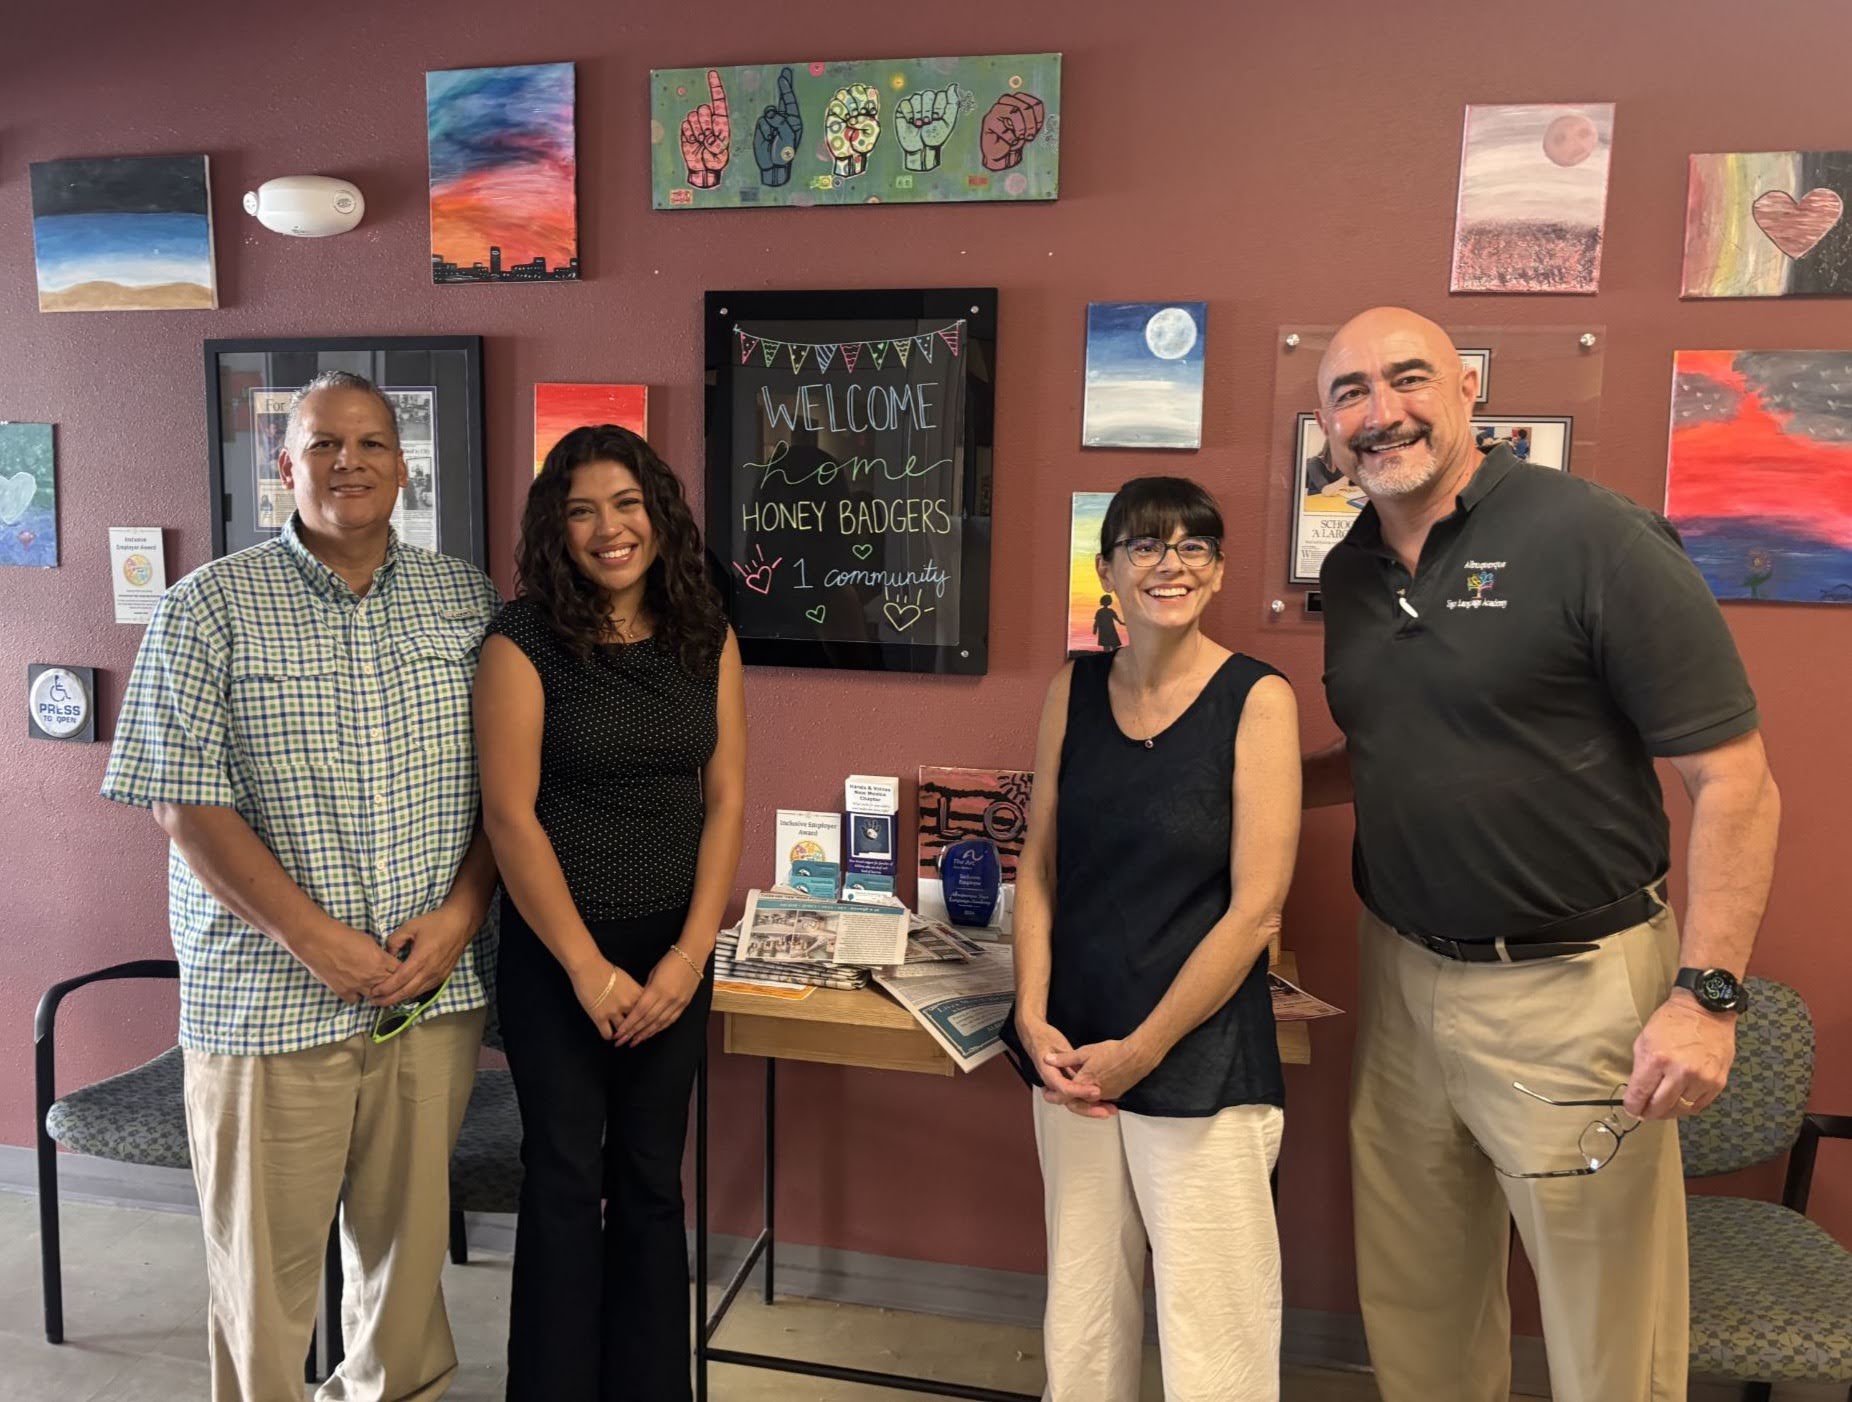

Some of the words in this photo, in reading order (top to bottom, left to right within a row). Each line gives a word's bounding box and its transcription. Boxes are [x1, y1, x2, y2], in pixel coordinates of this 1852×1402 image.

[265, 398, 285, 412] For
[761, 382, 939, 433] WELCOME
[743, 440, 953, 490] home
[742, 500, 827, 532] HONEY
[839, 498, 951, 535] BADGERS
[793, 558, 814, 589] 1
[824, 558, 951, 598] community
[39, 703, 81, 716] PRESS
[56, 716, 77, 724] OPEN
[779, 819, 807, 828] Inclusive
[807, 821, 838, 831] Employer
[798, 829, 819, 837] Award
